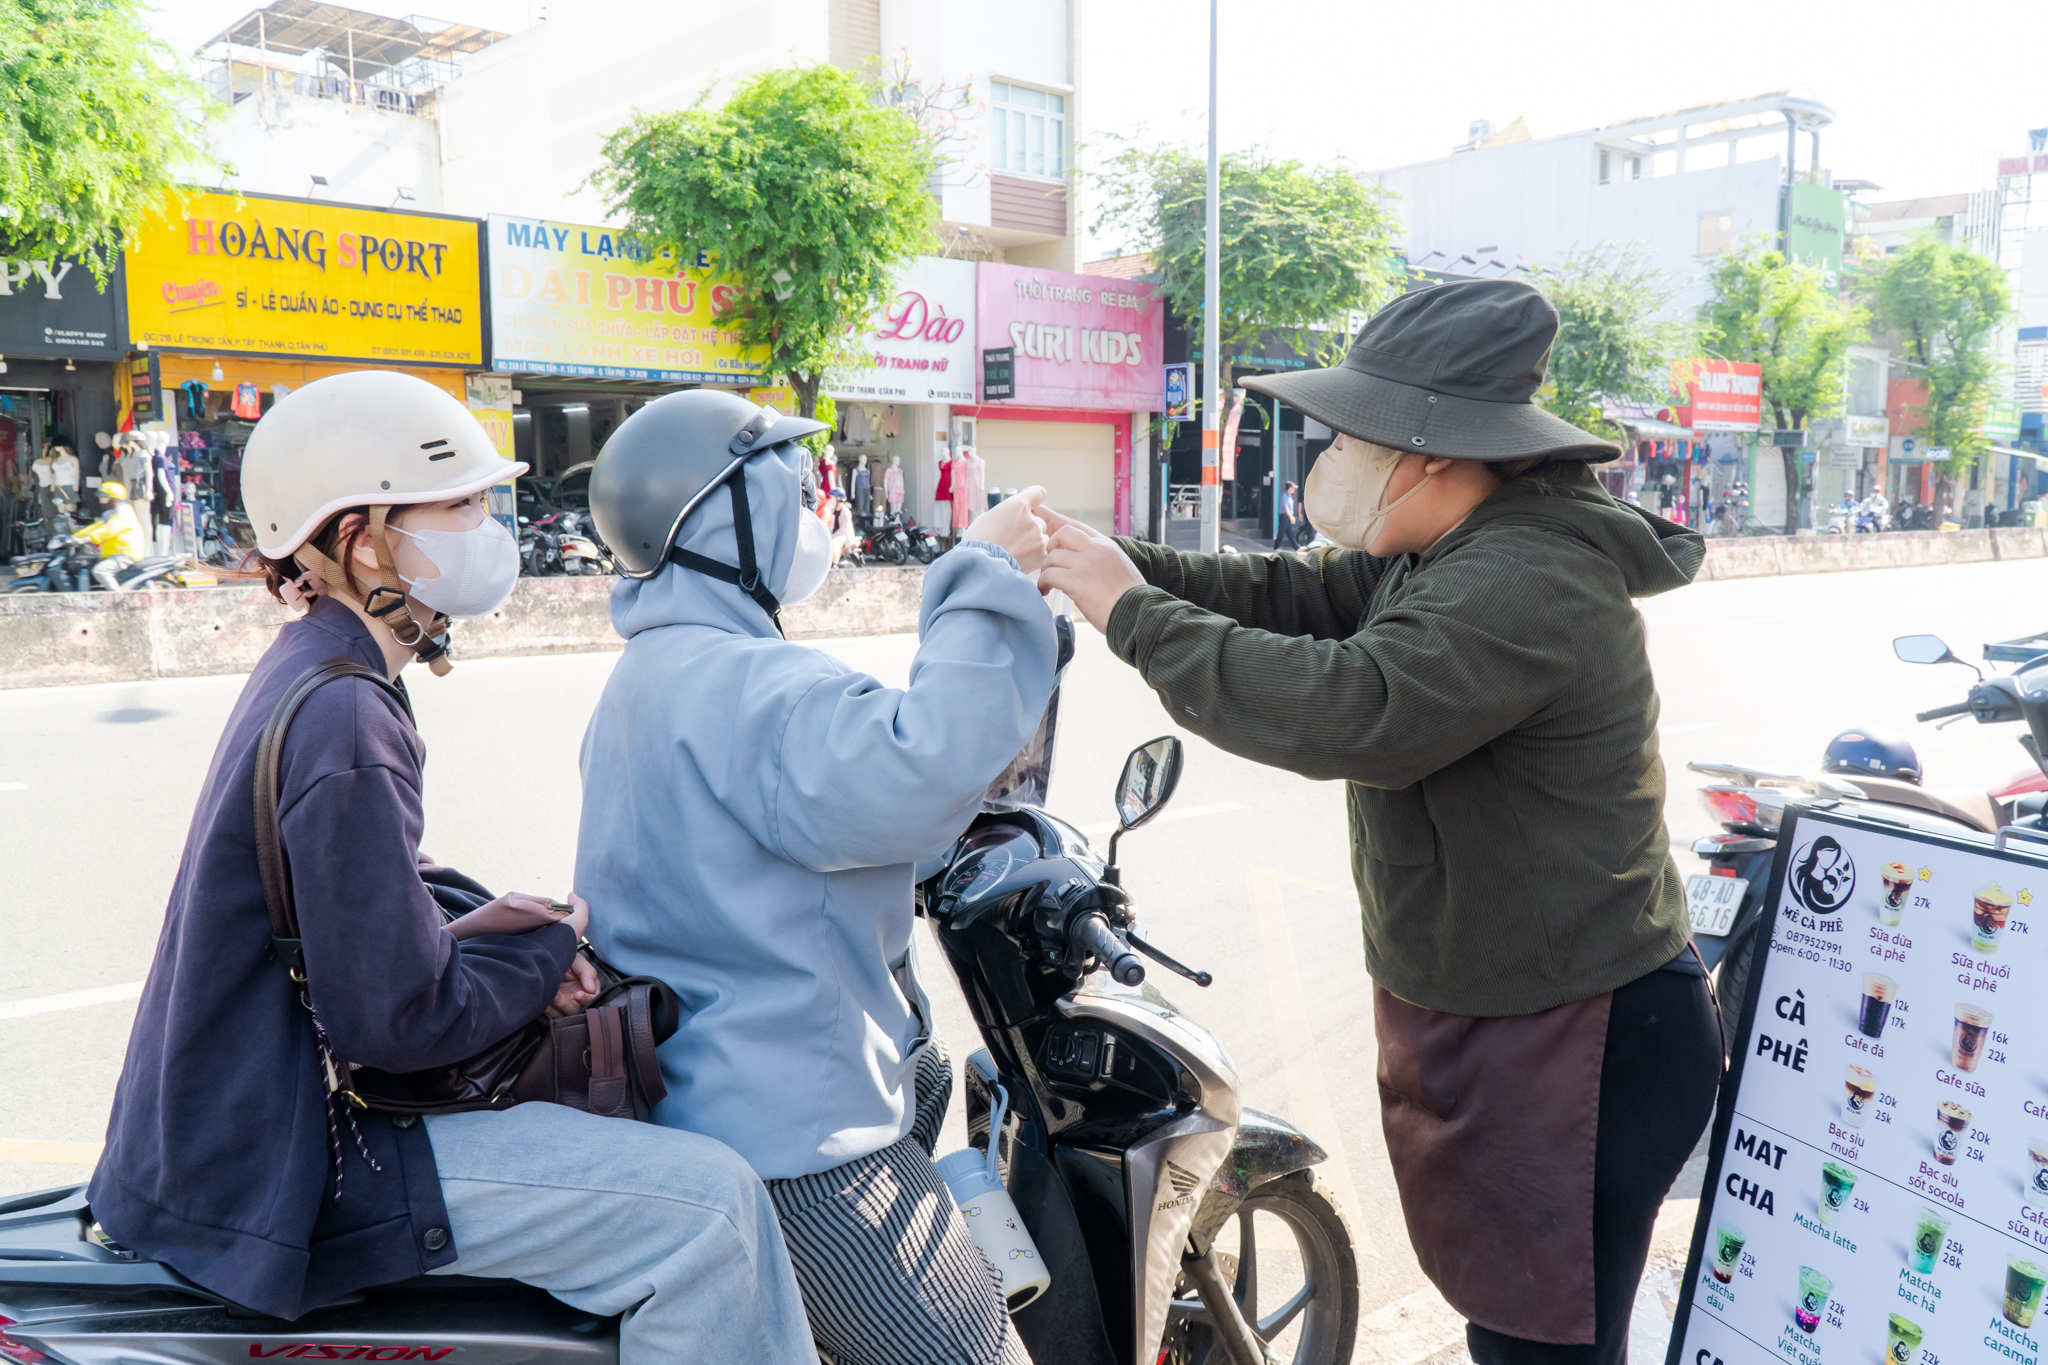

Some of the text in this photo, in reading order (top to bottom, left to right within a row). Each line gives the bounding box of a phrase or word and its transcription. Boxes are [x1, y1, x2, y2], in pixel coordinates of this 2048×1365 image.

[507, 220, 569, 251] MÁY
[188, 218, 448, 281] HOÀNG SPORT
[500, 264, 697, 315] ĐẠI PHÚ
[1014, 278, 1046, 299] THỜI
[1048, 286, 1092, 304] TRANG
[321, 295, 339, 315] ÁO
[350, 300, 383, 321] DỤNG
[386, 302, 402, 323] CỤ
[406, 298, 428, 322] THỂ
[431, 307, 462, 324] THAO
[877, 291, 964, 343] Đào
[503, 313, 561, 331] CHUYÊN
[566, 313, 593, 334] SỬA
[597, 318, 633, 338] CHỮA
[645, 319, 669, 340] LẤP
[673, 324, 697, 346] ĐẶT
[504, 335, 700, 366] MÁY LẠNH XE HƠI
[1009, 320, 1142, 365] SURI KIDS
[891, 357, 950, 372] TRANG NỮ
[1914, 896, 1931, 909] 27k
[1782, 906, 1843, 932] MÊ CÀ PHÊ
[2010, 920, 2029, 935] 27k
[1786, 930, 1842, 955] 0879522991
[1869, 926, 1913, 949] Sữa dừa
[1770, 939, 1852, 973] Open: 6:00 11:30
[1870, 943, 1906, 963] cà phê
[1951, 952, 2011, 980] Sữa chuối
[1957, 971, 1997, 993] cà phê
[1775, 988, 1806, 1026] CÀ
[1894, 999, 1910, 1012] 12k
[1891, 1016, 1906, 1029] 17k
[1844, 1034, 1885, 1058] Cafe đá
[1992, 1030, 2009, 1045] 16k
[1756, 1033, 1809, 1073] PHÊ
[1987, 1048, 2007, 1064] 22k
[1935, 1069, 1986, 1098] Cafe sữa
[1879, 1092, 1898, 1109] 20k
[2023, 1100, 2048, 1120] Caf
[1875, 1109, 1892, 1125] 25k
[1828, 1122, 1847, 1140] Bạc
[1970, 1128, 1991, 1146] 20k
[1734, 1128, 1788, 1171] MAT
[1830, 1141, 1859, 1161] muối
[1966, 1146, 1985, 1163] 25k
[1919, 1160, 1940, 1180] Bạc
[1725, 1172, 1774, 1217] CHA
[1908, 1175, 1965, 1209] sốt socola
[1157, 1196, 1194, 1211] HONDA
[1853, 1198, 1871, 1214] 23k
[1793, 1212, 1858, 1254] Matcha latte
[2007, 1219, 2030, 1238] sữa
[1945, 1238, 1965, 1256] 25k
[1741, 1251, 1757, 1268] 22k
[1942, 1252, 1962, 1270] 28k
[1738, 1263, 1754, 1279] 26k
[1701, 1274, 1735, 1302] Matcha
[1898, 1267, 1942, 1300] Matcha
[1706, 1294, 1724, 1312] dâu
[1829, 1300, 1846, 1317] 22k
[1897, 1283, 1936, 1314] bạc hà
[1826, 1312, 1843, 1330] 26k
[1783, 1324, 1821, 1355] Matcha
[1989, 1316, 2039, 1353] Matcha
[249, 1342, 456, 1362] VISION
[1777, 1335, 1797, 1357] Việt
[1921, 1349, 1941, 1365] 22k
[1983, 1335, 2038, 1365] caramel
